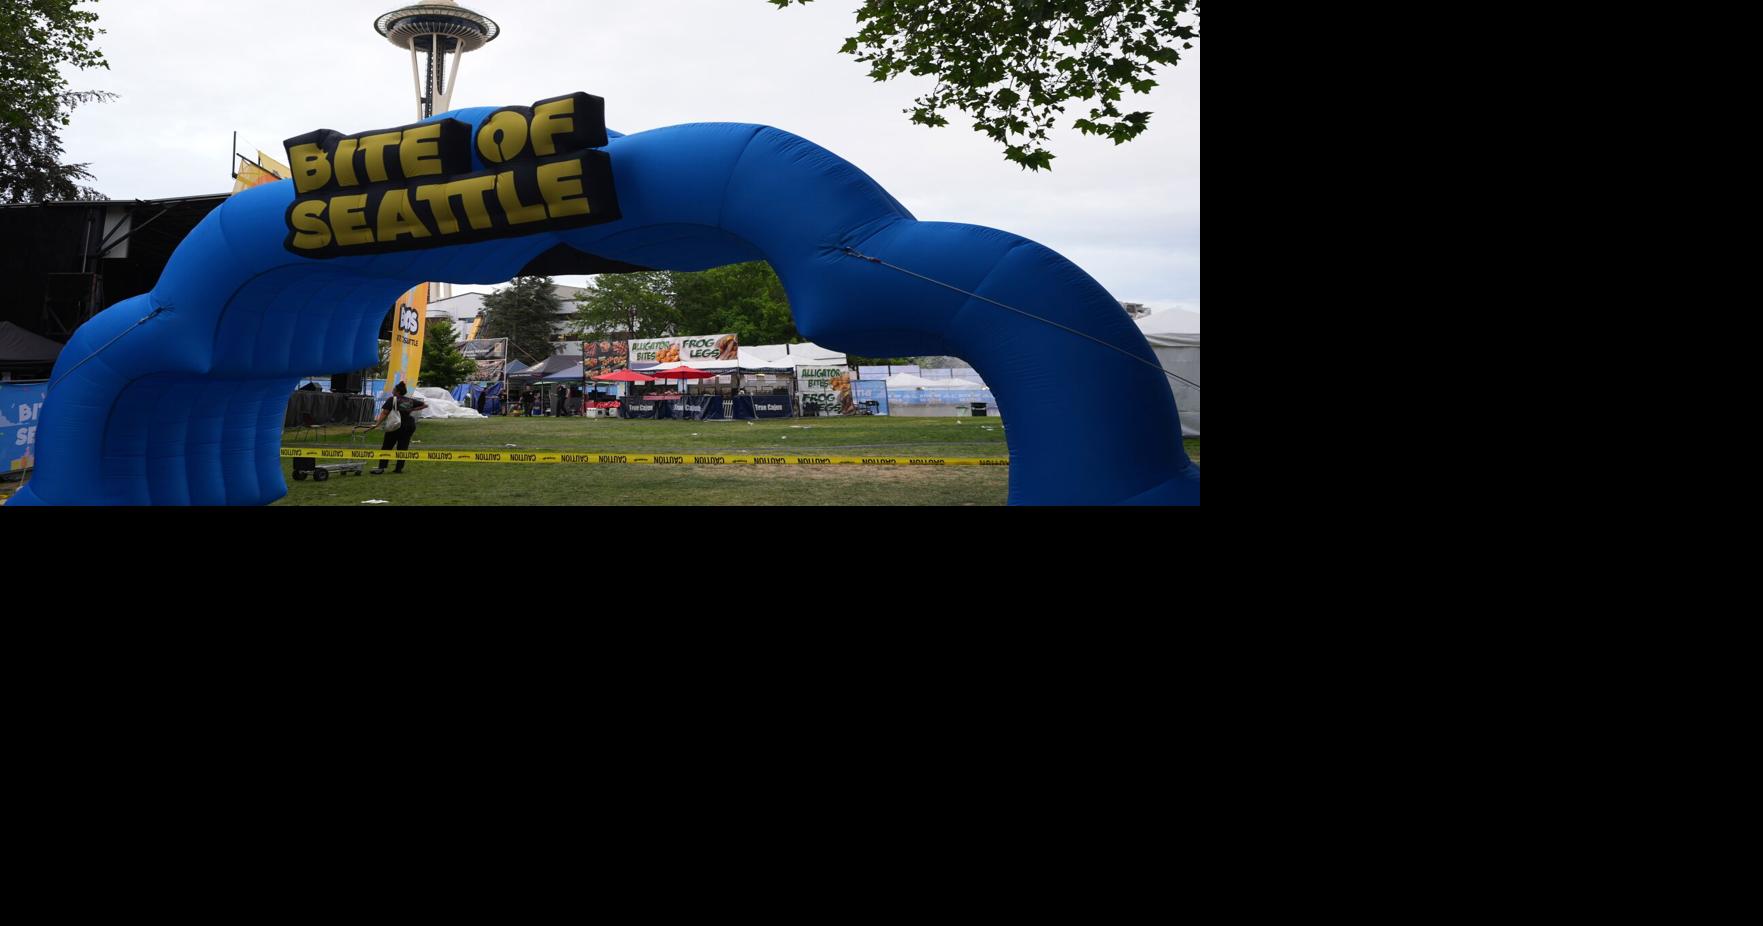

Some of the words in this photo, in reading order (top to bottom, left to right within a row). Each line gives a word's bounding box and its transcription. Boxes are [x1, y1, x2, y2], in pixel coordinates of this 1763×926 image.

[289, 123, 442, 194] BITE
[477, 98, 575, 163] OF
[291, 158, 590, 250] SEATTLE
[632, 341, 670, 351] ALLIGATOR
[682, 338, 715, 348] FROG
[637, 352, 656, 360] BITES
[690, 349, 720, 360] LEGS
[802, 369, 840, 378] ALLIGATOR
[808, 379, 829, 388] BITES
[802, 393, 835, 402] FROG
[281, 448, 302, 457] CAUTION
[352, 450, 375, 458] CAUTION
[396, 451, 420, 459] CAUTION
[427, 452, 452, 460] CAUTION
[475, 453, 501, 461] CAUTION
[510, 454, 537, 462] CAUTION
[561, 455, 589, 463] CAUTION
[599, 455, 627, 464] CAUTION
[653, 455, 683, 464] CAUTION
[694, 456, 725, 465] CAUTION
